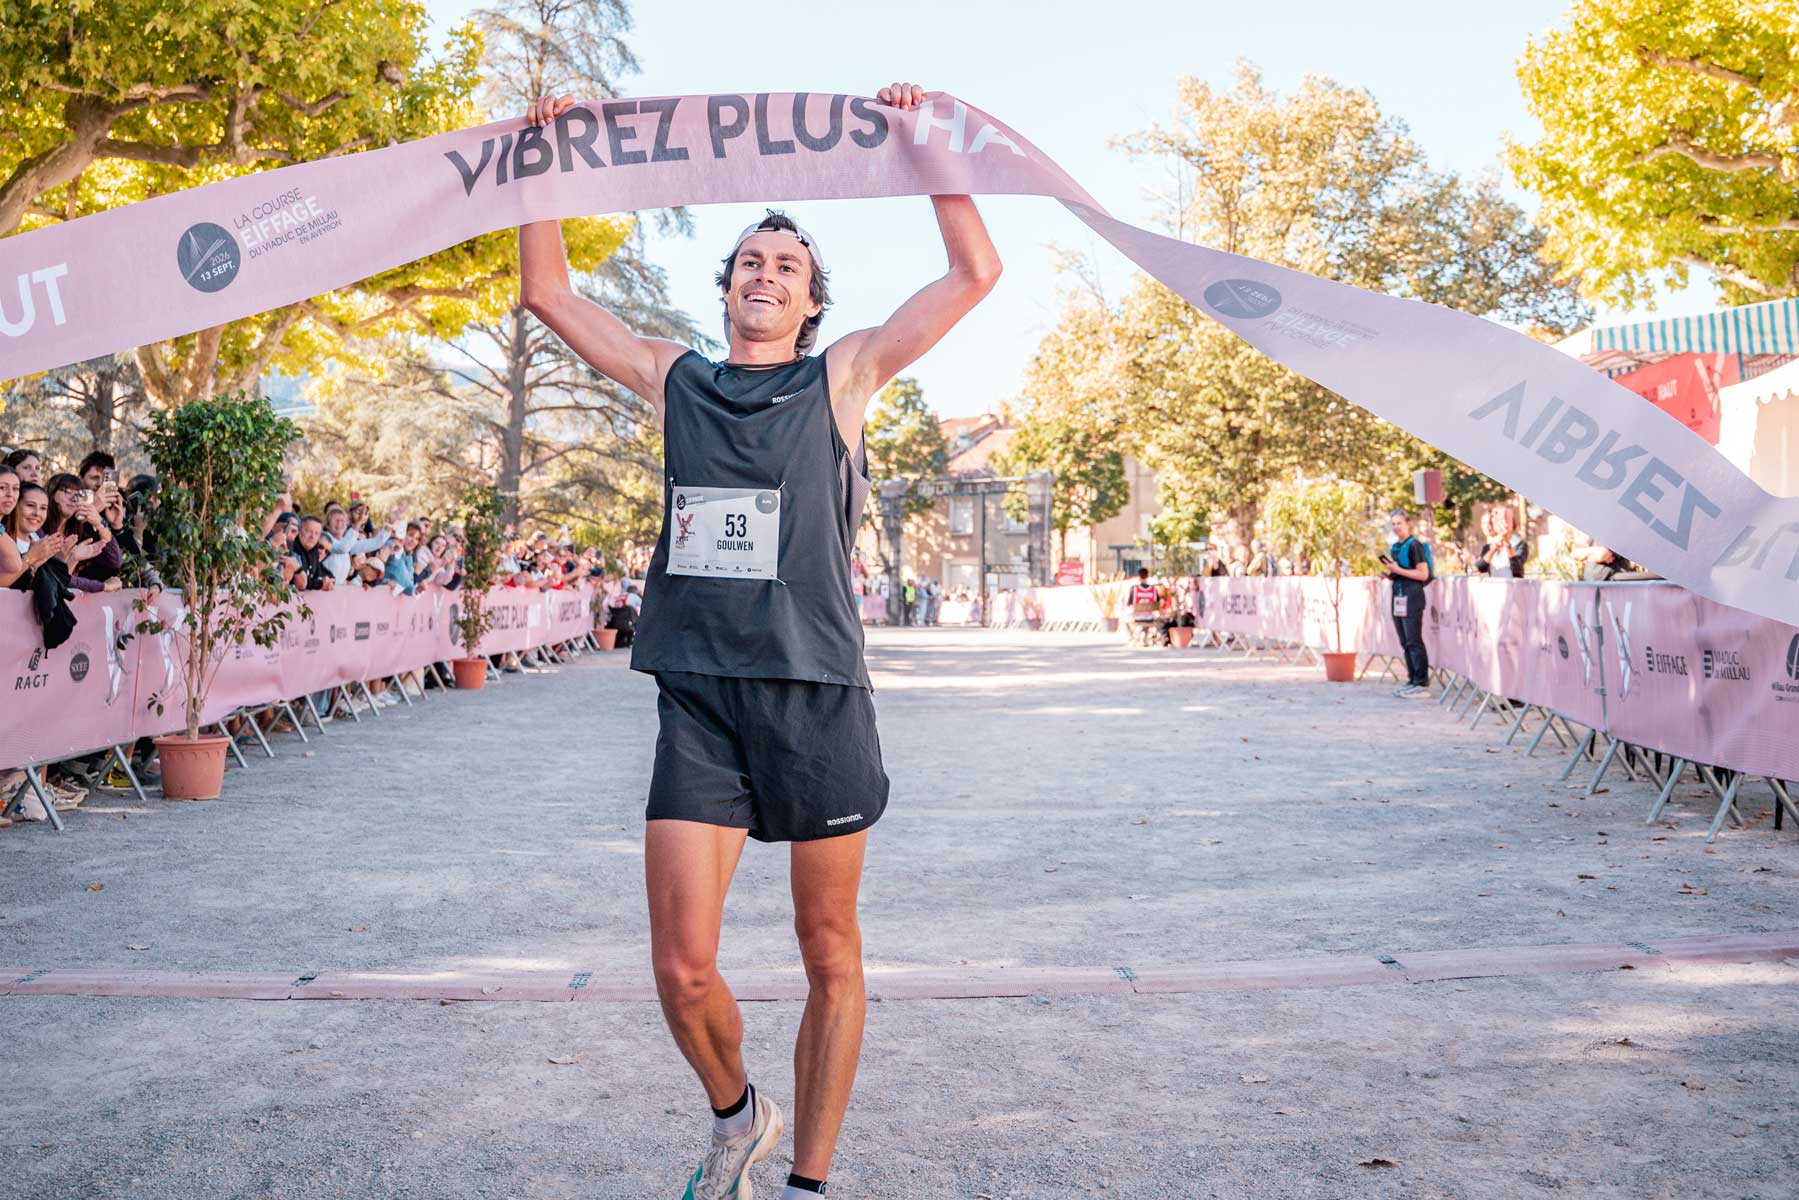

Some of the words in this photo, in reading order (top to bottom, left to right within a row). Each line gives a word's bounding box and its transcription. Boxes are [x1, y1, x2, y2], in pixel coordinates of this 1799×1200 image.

[444, 98, 690, 197] VIBREZ
[707, 92, 893, 158] PLUS
[233, 213, 251, 230] LA
[252, 187, 303, 220] COURSE
[238, 195, 323, 248] EIFFAGE
[310, 219, 343, 241] AVEYRON
[250, 247, 262, 259] DU
[263, 230, 295, 255] VIADUC
[295, 224, 308, 236] DE
[308, 209, 339, 229] MILLAU
[211, 250, 231, 266] 2026
[200, 270, 212, 281] 13
[212, 259, 236, 277] SEPT.
[724, 513, 747, 537] 53
[716, 540, 754, 551] GOULWEN
[1656, 653, 1688, 676] EIFFAGE
[1720, 666, 1751, 681] MILLAU
[15, 673, 49, 691] RAGT
